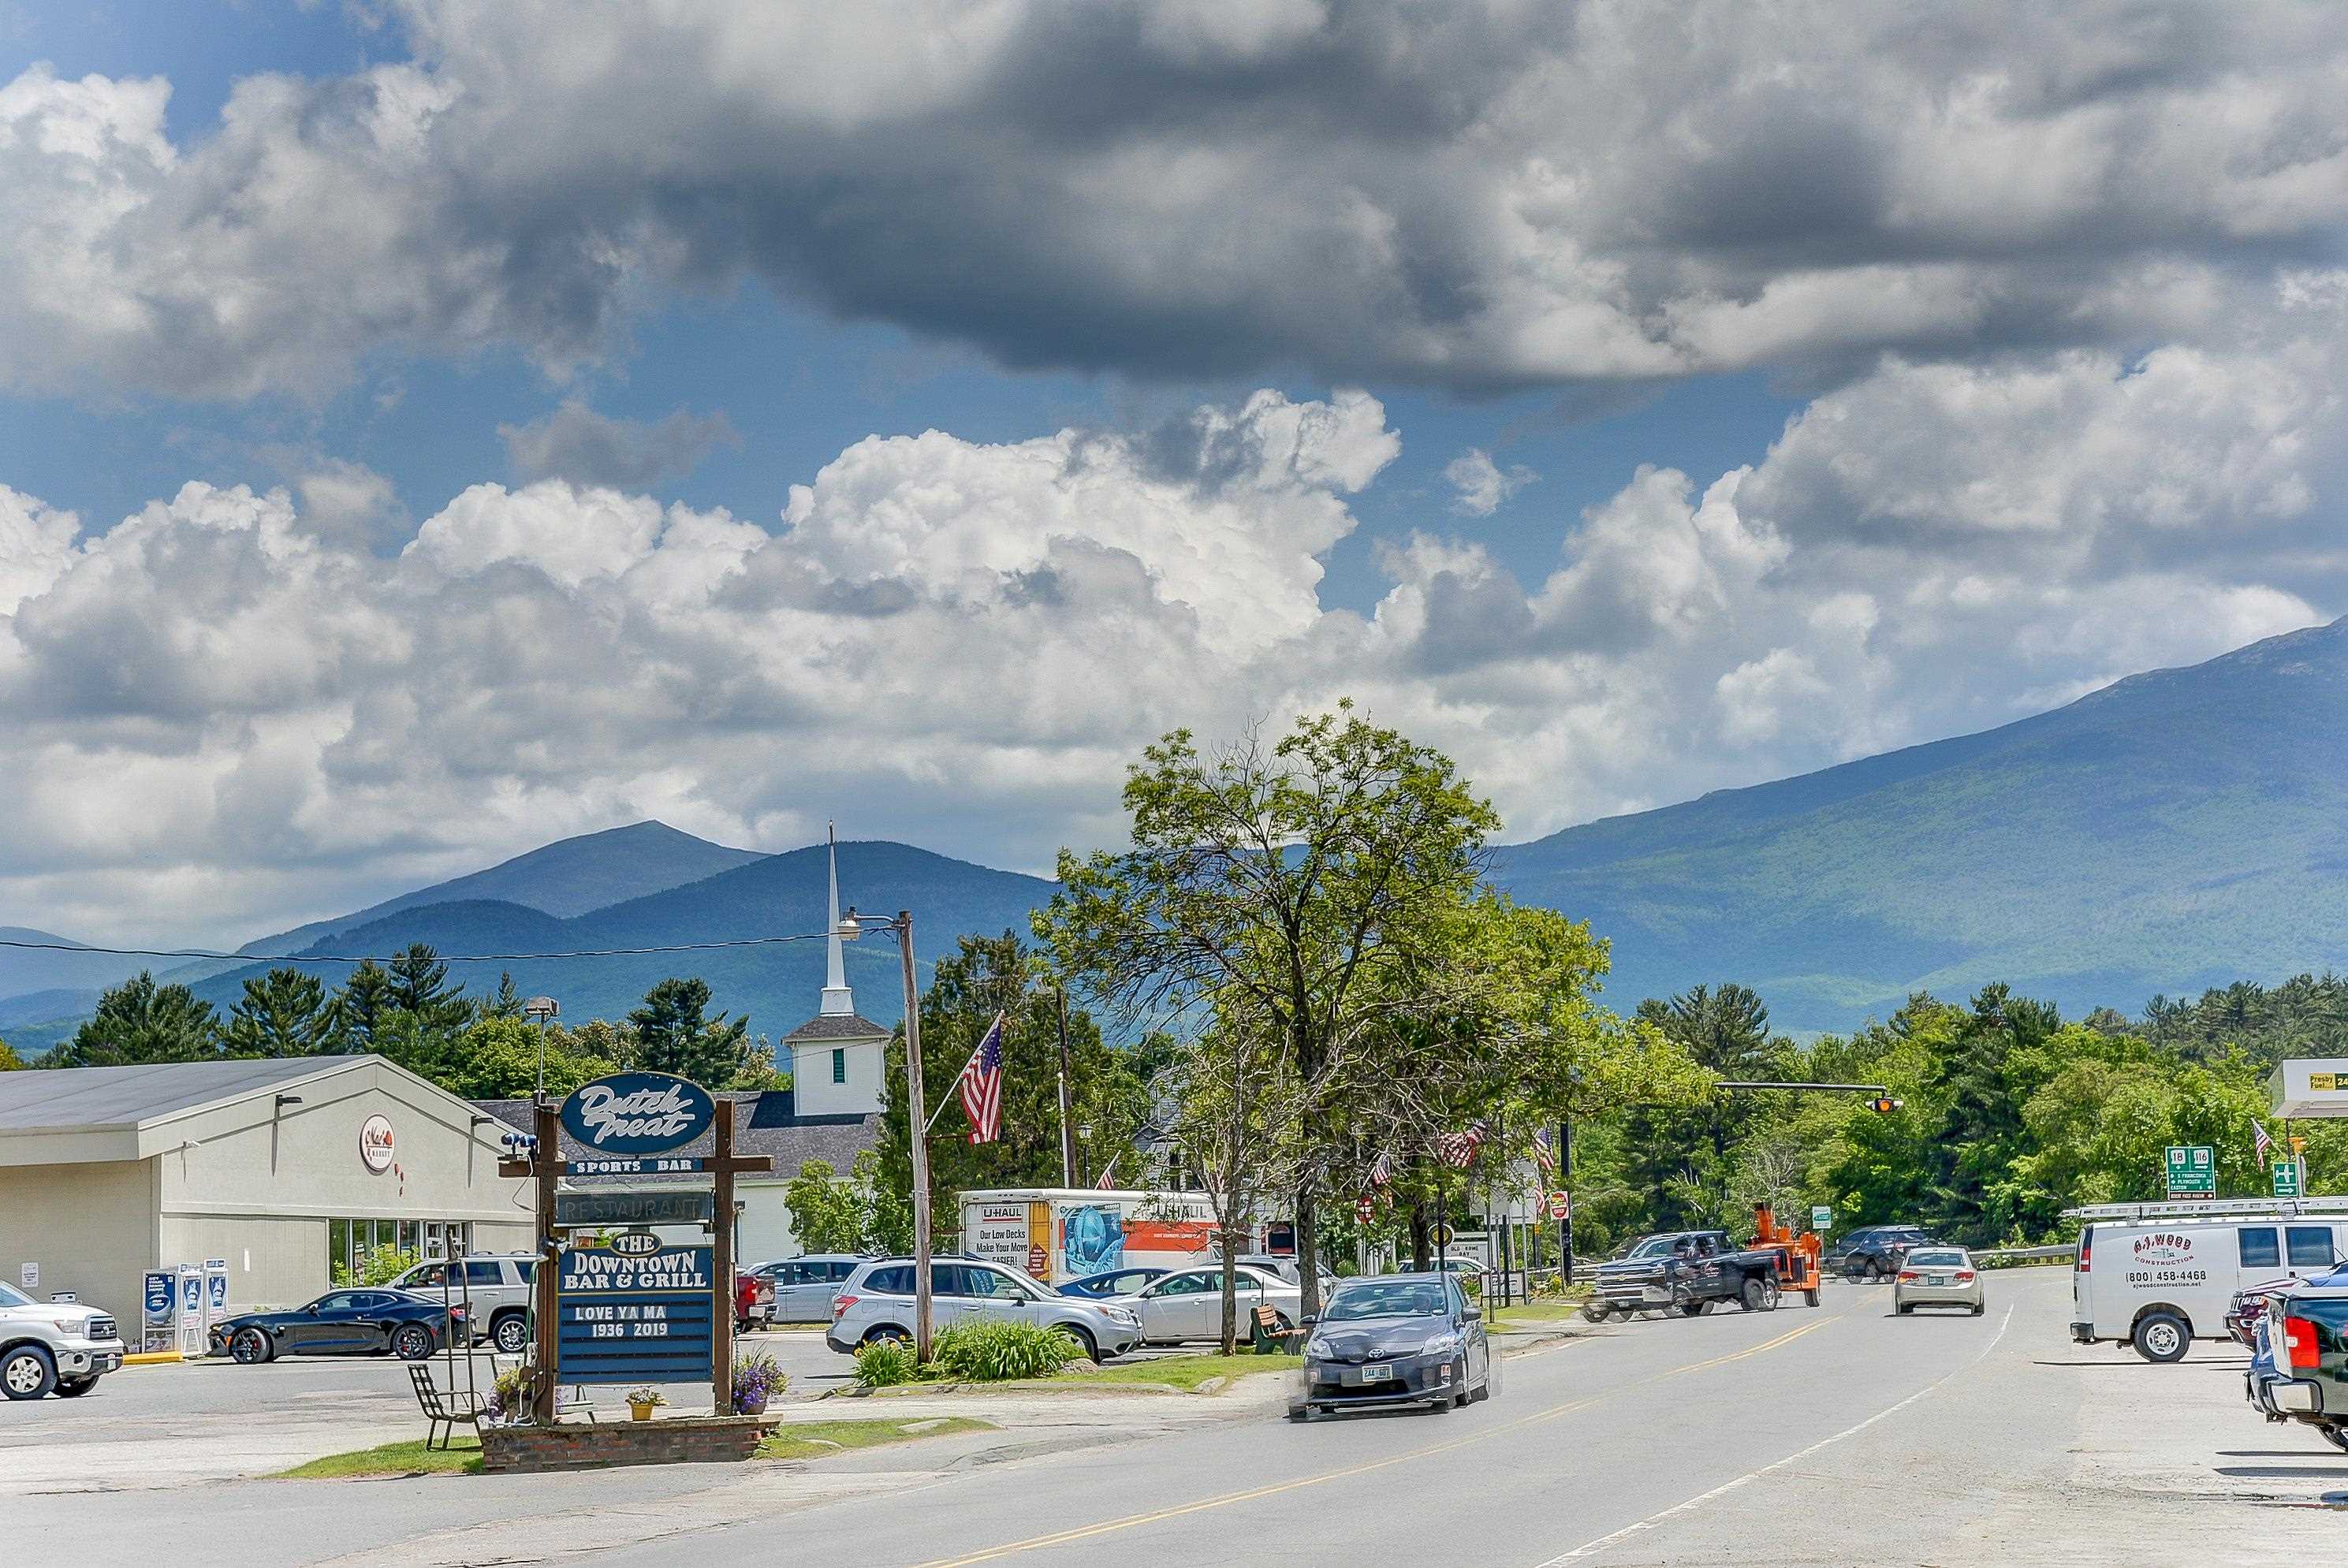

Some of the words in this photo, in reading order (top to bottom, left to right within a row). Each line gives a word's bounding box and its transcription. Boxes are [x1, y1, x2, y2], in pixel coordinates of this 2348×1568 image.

[580, 1084, 694, 1115] Dutch
[583, 1111, 695, 1145] Treat
[2174, 1153, 2183, 1161] 18
[2195, 1153, 2208, 1161] 116
[576, 1160, 641, 1173] SPORTS
[657, 1160, 692, 1171] BAR
[565, 1198, 700, 1221] RESTAURANT
[983, 1208, 1022, 1218] U-HAUL
[980, 1230, 991, 1240] Our
[992, 1229, 1005, 1240] Low
[1006, 1228, 1026, 1239] Decks
[617, 1235, 654, 1252] THE
[976, 1242, 994, 1253] Make
[995, 1242, 1011, 1253] Your
[1011, 1242, 1028, 1252] Move
[574, 1250, 696, 1275] DOWNTOWN
[2134, 1254, 2194, 1266] CONSTRUCTION
[564, 1274, 610, 1289] BAR
[616, 1273, 633, 1287] &
[638, 1272, 707, 1287] GRILL
[2126, 1272, 2152, 1283] (800)
[575, 1306, 613, 1320] LOVE
[617, 1306, 639, 1319] YA
[643, 1305, 666, 1319] MA
[592, 1324, 624, 1338] 1936
[634, 1323, 669, 1336] 2019
